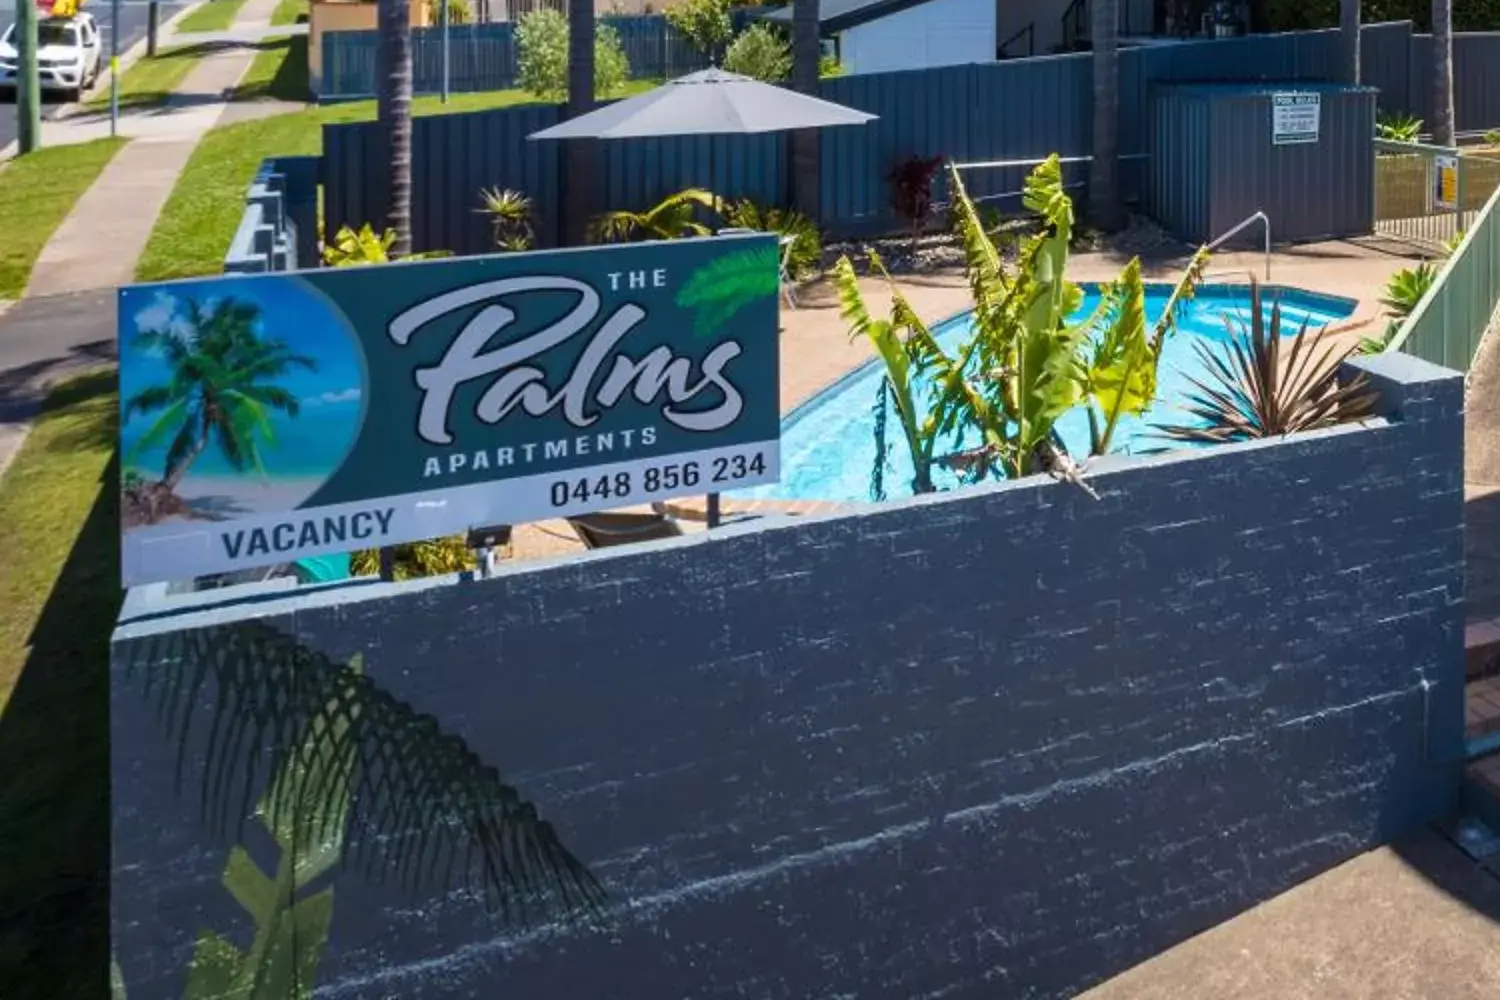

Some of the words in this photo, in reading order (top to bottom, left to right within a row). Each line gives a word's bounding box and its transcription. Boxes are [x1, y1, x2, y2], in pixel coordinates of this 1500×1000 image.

[608, 269, 668, 291] THE
[388, 275, 744, 444] Palms
[424, 426, 658, 477] APARTMENTS
[551, 472, 631, 508] 0448
[643, 461, 701, 494] 856
[712, 451, 767, 483] 234
[221, 507, 395, 560] VACANCY
